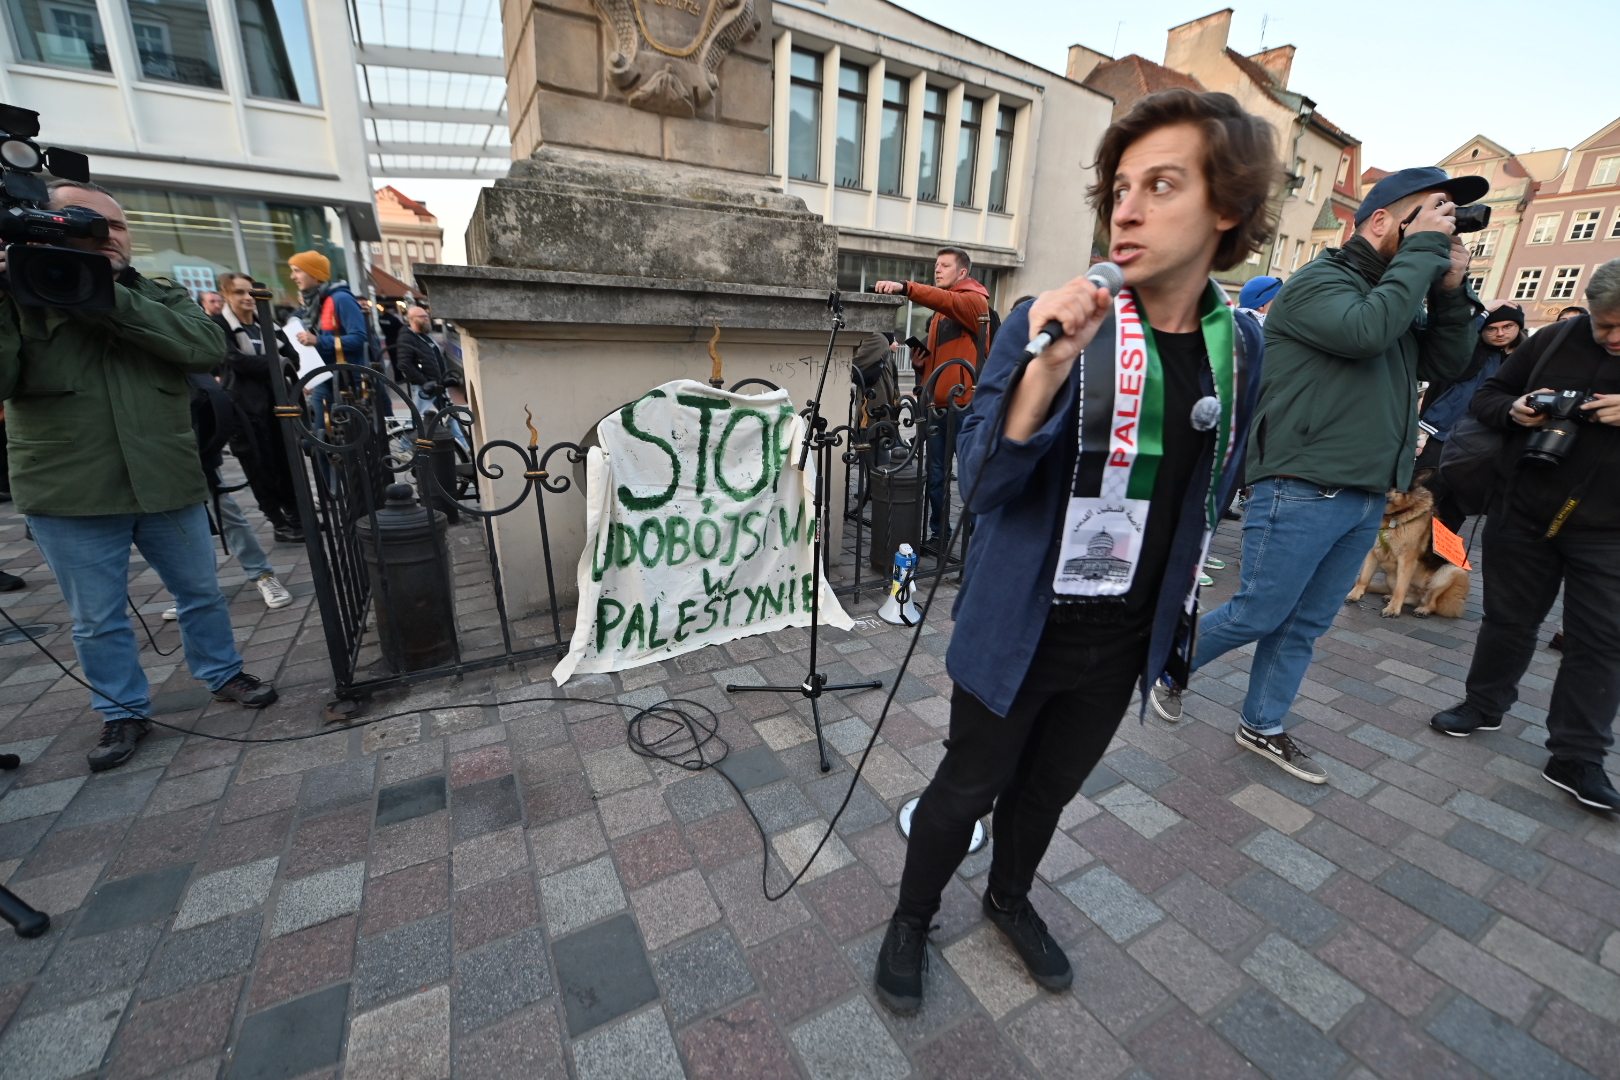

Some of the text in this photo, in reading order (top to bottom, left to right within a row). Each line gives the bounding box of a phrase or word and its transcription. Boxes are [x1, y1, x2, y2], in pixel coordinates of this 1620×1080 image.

[1108, 286, 1145, 468] PALESTIN
[617, 389, 795, 511] STOP
[703, 567, 738, 597] W
